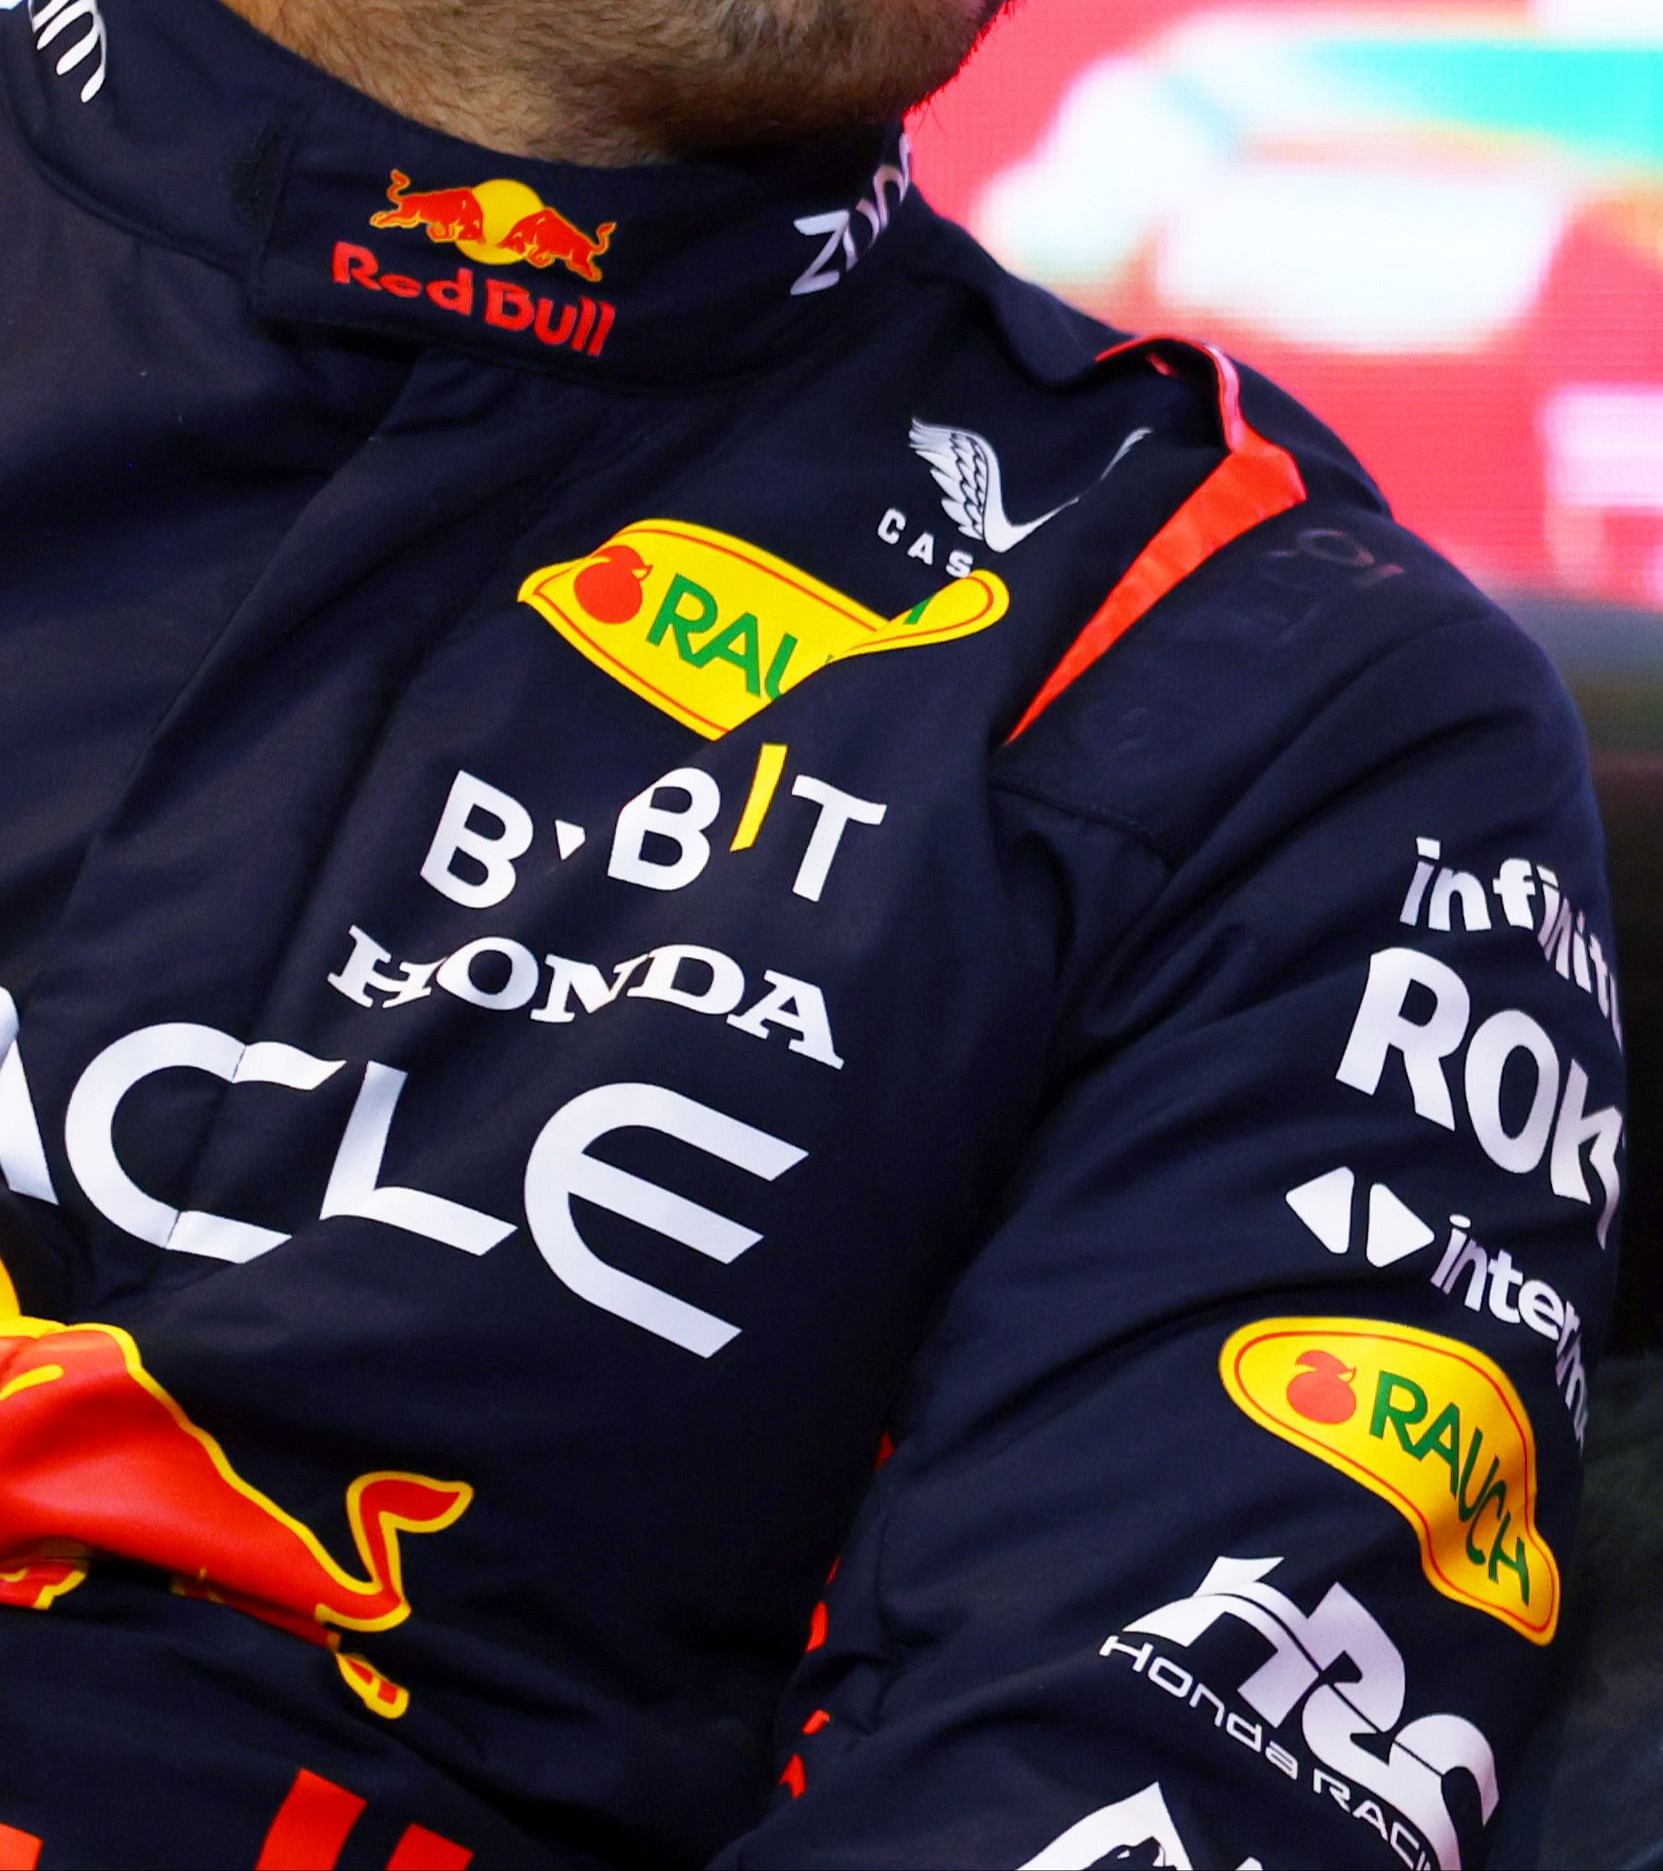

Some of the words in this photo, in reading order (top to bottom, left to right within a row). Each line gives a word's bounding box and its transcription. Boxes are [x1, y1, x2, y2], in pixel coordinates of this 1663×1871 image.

[332, 240, 474, 318] Red
[484, 277, 617, 358] Bull
[326, 924, 845, 1070] HONDA
[1335, 947, 1627, 1250] ROK
[1369, 1370, 1530, 1606] RAUCH
[1099, 1634, 1299, 1780] Honda
